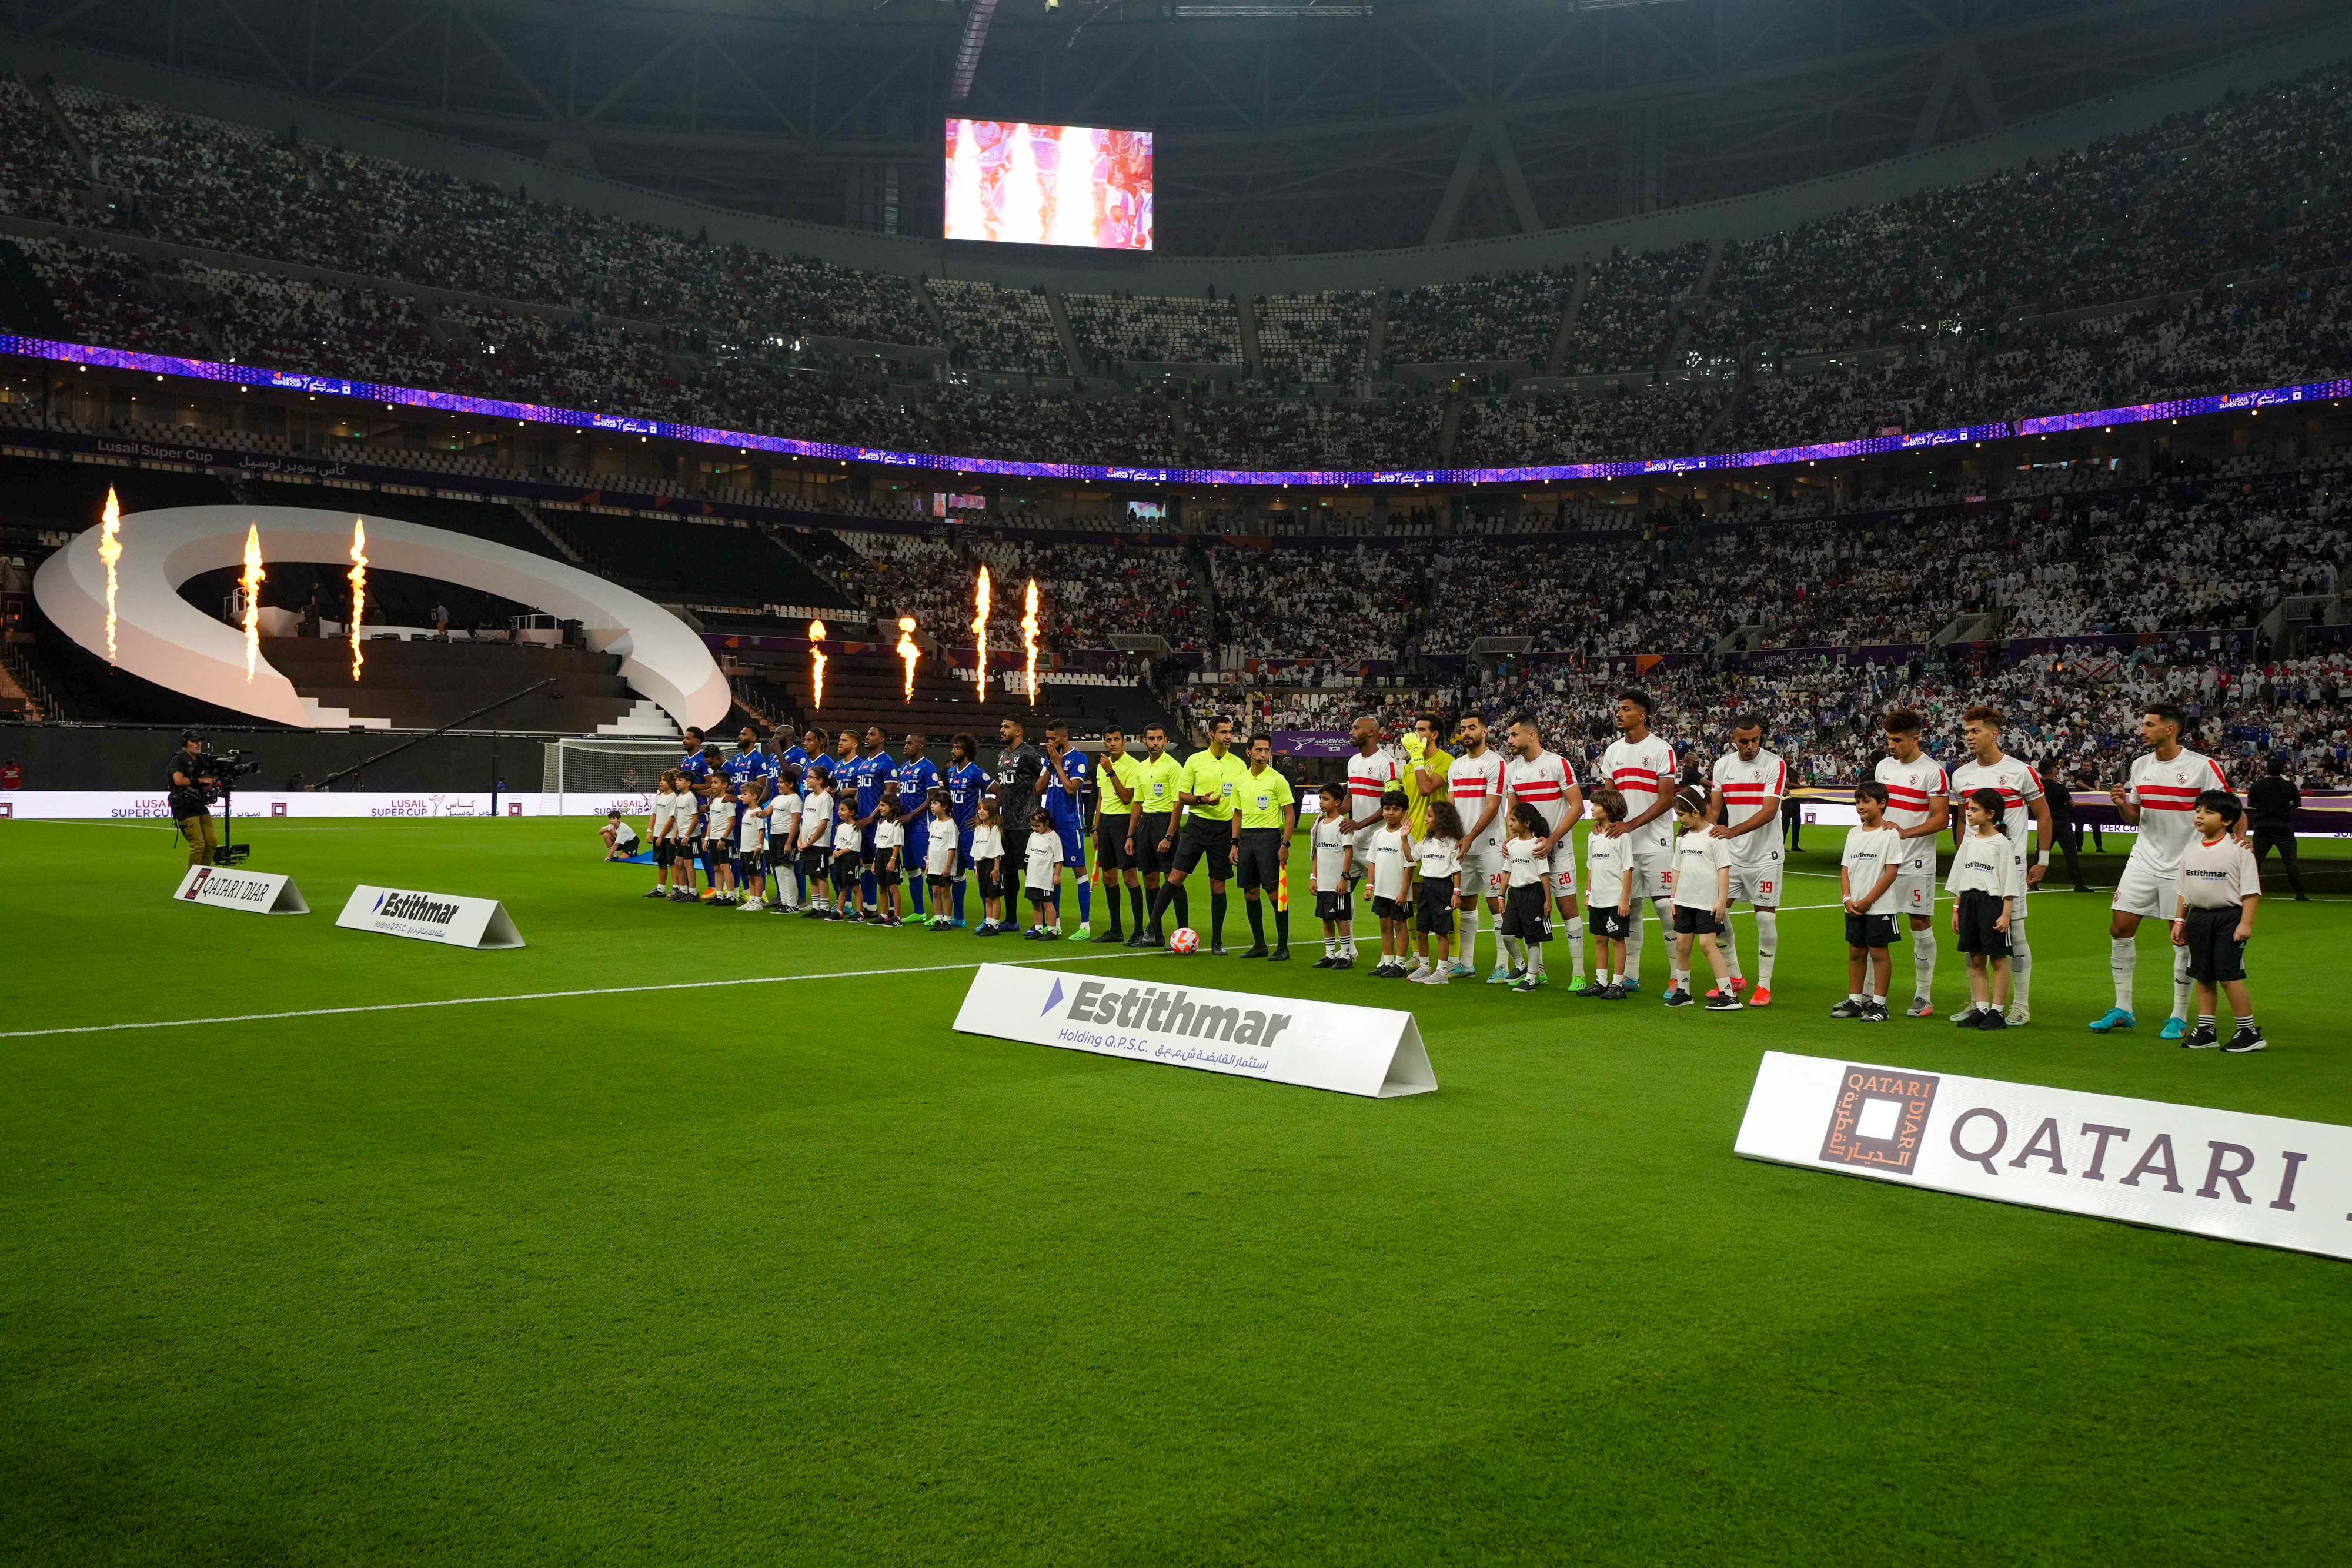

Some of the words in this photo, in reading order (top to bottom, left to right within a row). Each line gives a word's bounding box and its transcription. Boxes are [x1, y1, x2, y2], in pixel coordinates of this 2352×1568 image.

[96, 440, 139, 454] Lusail
[142, 444, 185, 459] Super
[185, 450, 213, 463] Cup
[239, 456, 282, 470] لوسيل
[283, 464, 316, 473] سوبر
[319, 462, 348, 477] كأس
[135, 800, 171, 808] LUSAI
[445, 798, 476, 810] كأس
[111, 809, 151, 817] SUPER
[153, 809, 173, 817] CU
[371, 808, 405, 817] SUPER
[407, 808, 427, 817] CUP
[1489, 873, 1501, 885] 24
[1558, 872, 1571, 885] 28
[1661, 871, 1672, 883] 36
[203, 877, 244, 897] QATARI
[241, 882, 270, 902] DIAR
[1759, 881, 1772, 893] 39
[1914, 889, 1920, 901] 5
[380, 892, 460, 925] Estithmar
[373, 920, 390, 931] Holding
[1067, 981, 1292, 1048] Estithmar
[1058, 1028, 1103, 1048] Holding
[1105, 1035, 1148, 1053] Q.P.S.C.
[1848, 1074, 1932, 1098] QATARI
[1897, 1099, 1926, 1149] DIAR
[1949, 1107, 2308, 1213] QATARI
